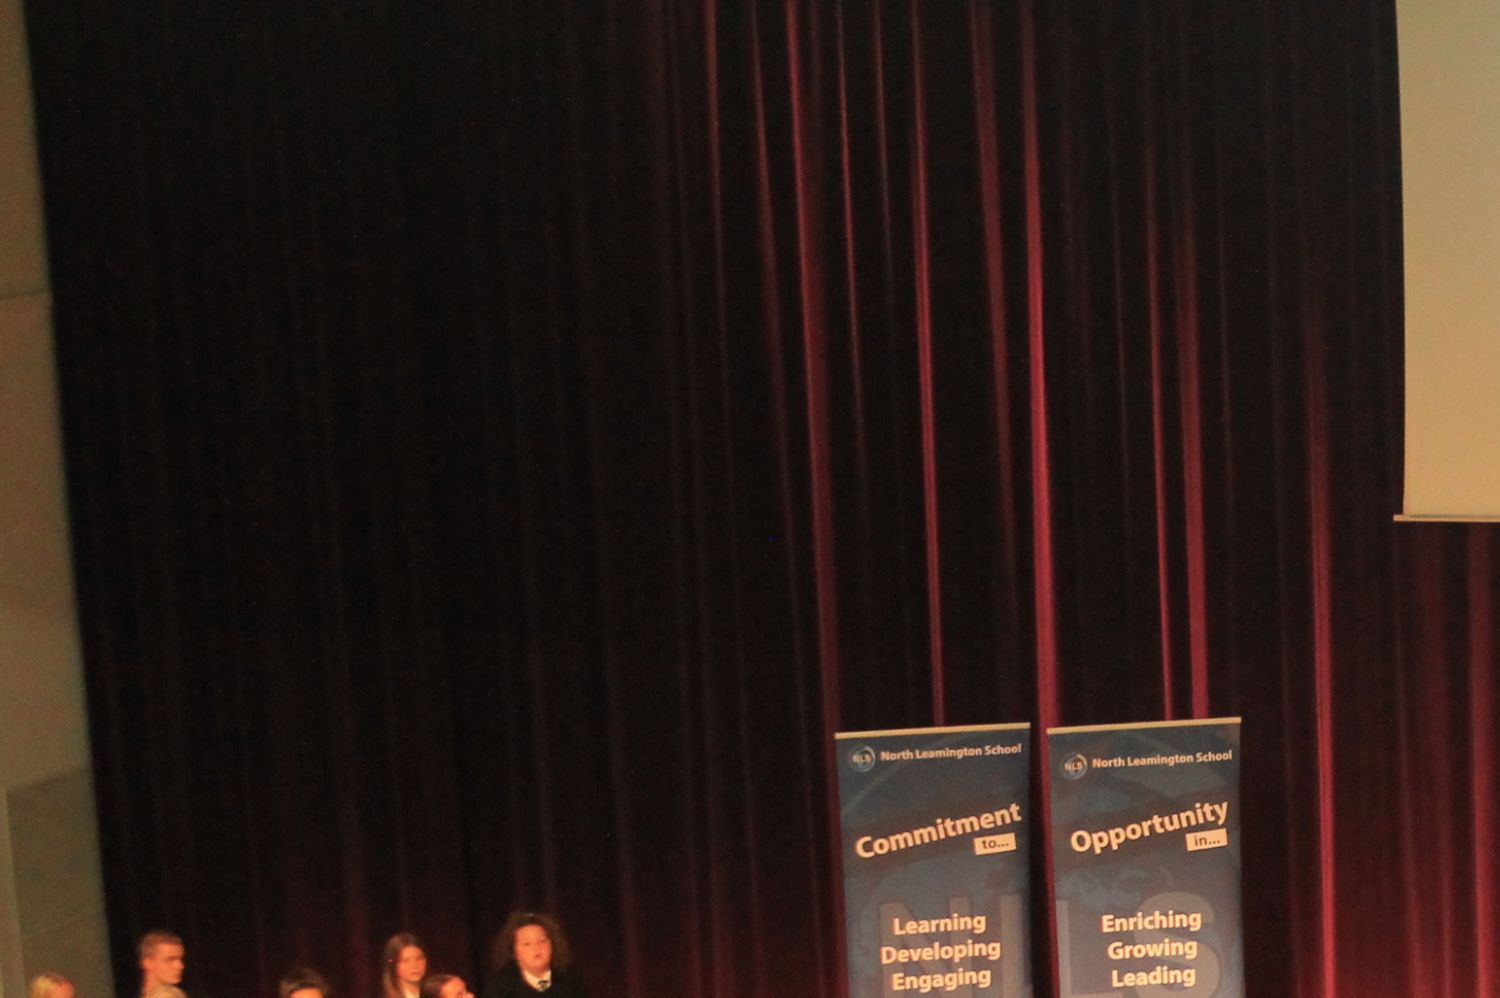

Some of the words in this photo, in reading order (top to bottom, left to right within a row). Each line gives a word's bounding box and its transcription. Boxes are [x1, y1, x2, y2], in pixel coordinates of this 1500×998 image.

[880, 750, 914, 761] North
[915, 748, 982, 759] Leamington
[984, 744, 1022, 755] School
[1092, 757, 1125, 768] North
[1127, 755, 1194, 766] Leamington
[1196, 750, 1232, 762] School
[856, 804, 1022, 857] Commitment
[1071, 803, 1228, 853] Opportunity
[894, 914, 986, 935] Learning
[1102, 911, 1201, 932] Enriching
[881, 940, 1001, 963] Developing
[1108, 939, 1198, 959] Growing
[892, 968, 991, 992] Engaging
[1112, 966, 1196, 987] Leading
